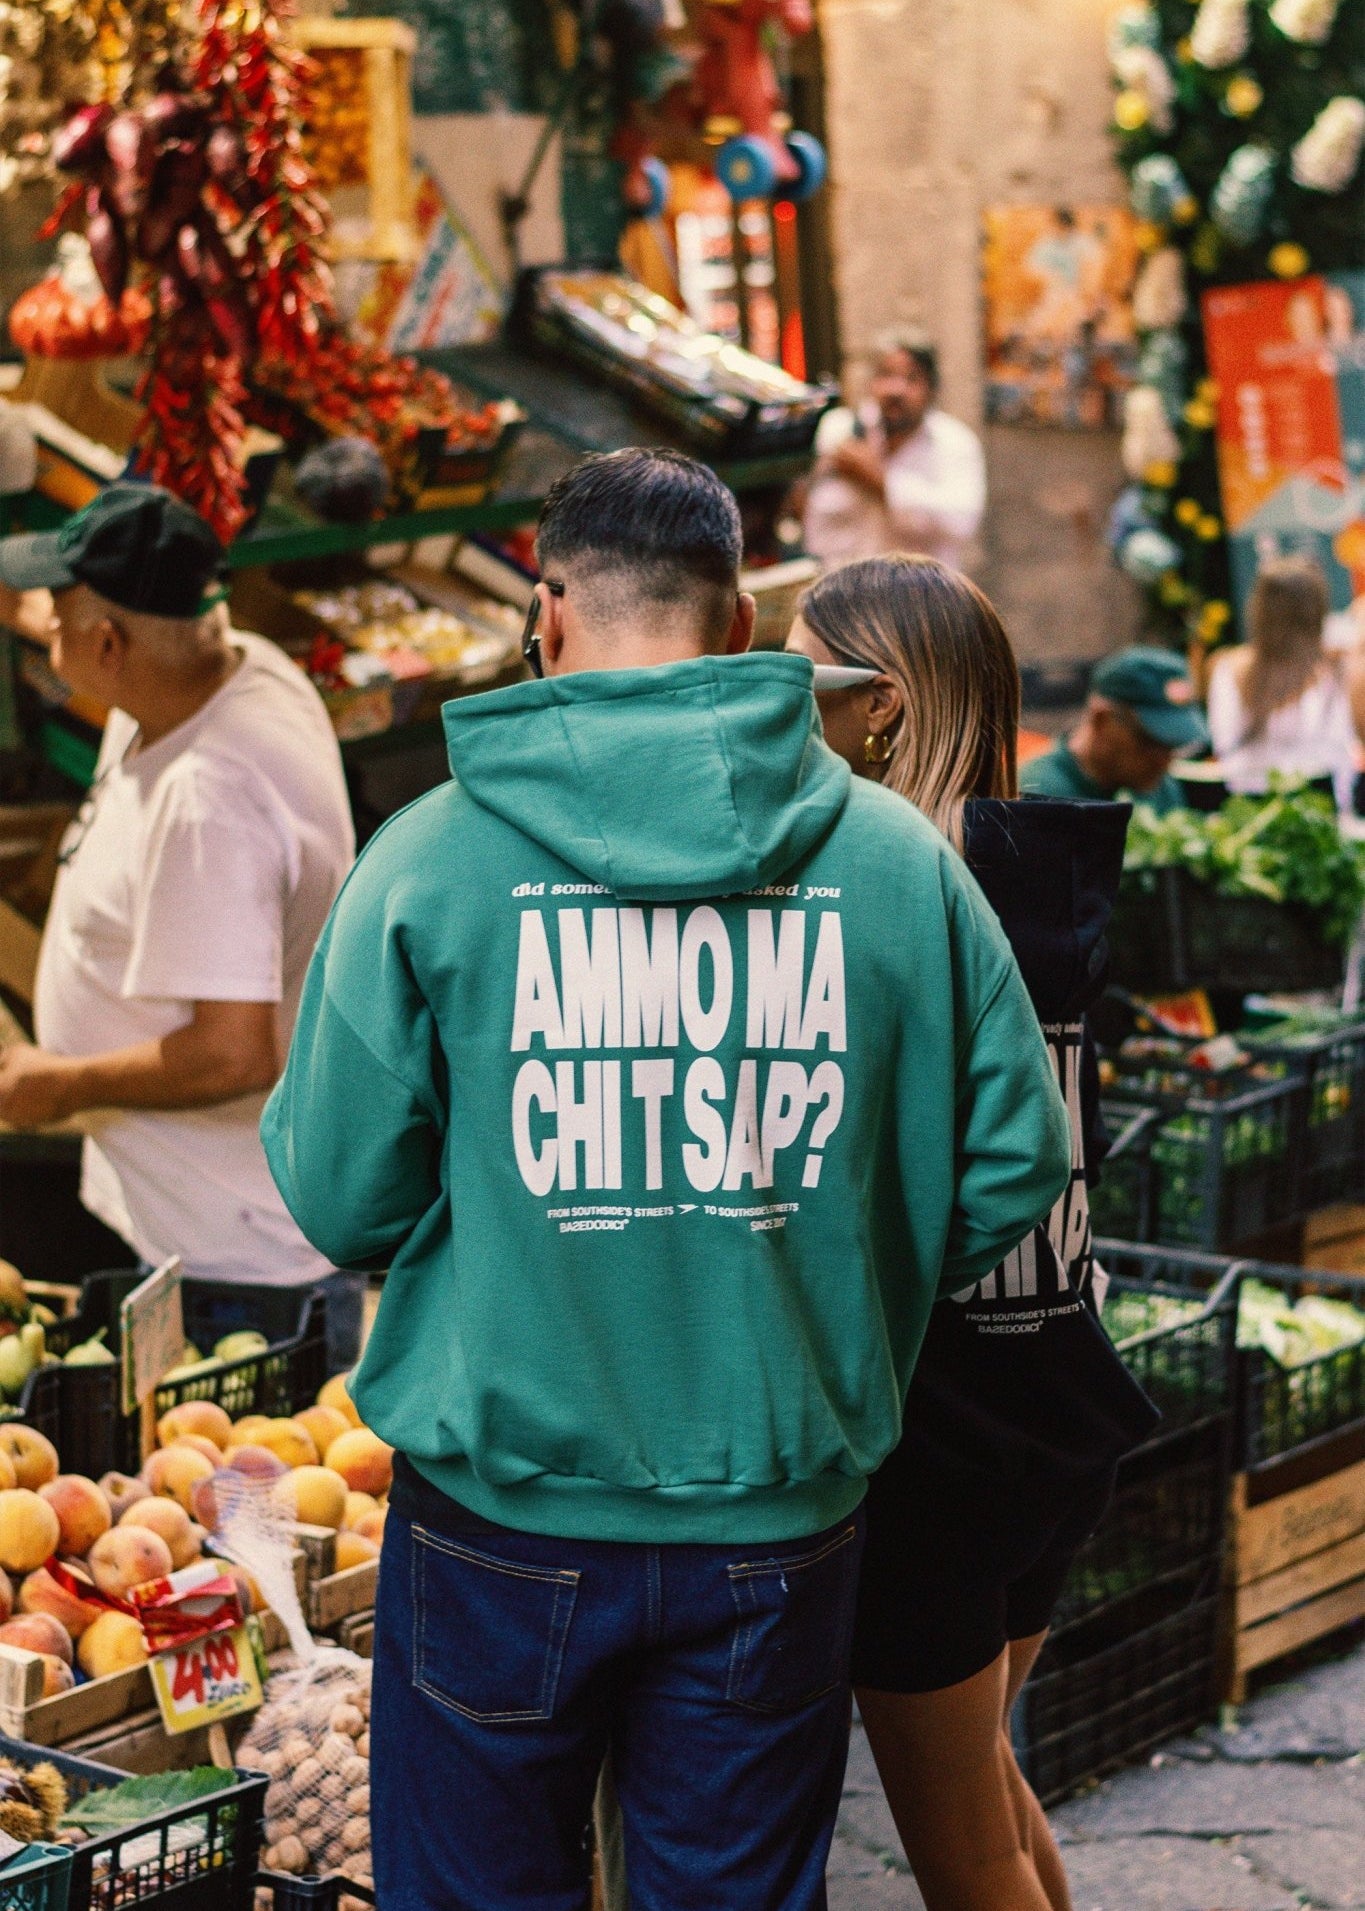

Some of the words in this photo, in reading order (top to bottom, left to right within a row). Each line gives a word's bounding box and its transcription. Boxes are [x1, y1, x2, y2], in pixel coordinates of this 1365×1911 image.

[511, 882, 545, 897] did
[551, 883, 614, 895] some
[803, 886, 842, 900] you
[511, 906, 733, 1051] AMMO
[746, 909, 847, 1051] MA
[512, 1059, 622, 1196] CHI
[632, 1058, 674, 1190] T
[682, 1057, 845, 1192] SAP?
[547, 1208, 570, 1218] FROM
[571, 1205, 632, 1217] SOUTHSIDE'S
[634, 1206, 674, 1217] STREETS
[703, 1205, 717, 1215] TO
[965, 1313, 990, 1321] FROM
[992, 1309, 1046, 1321] SOUTHSIDE'S
[1048, 1303, 1080, 1317] STREETS
